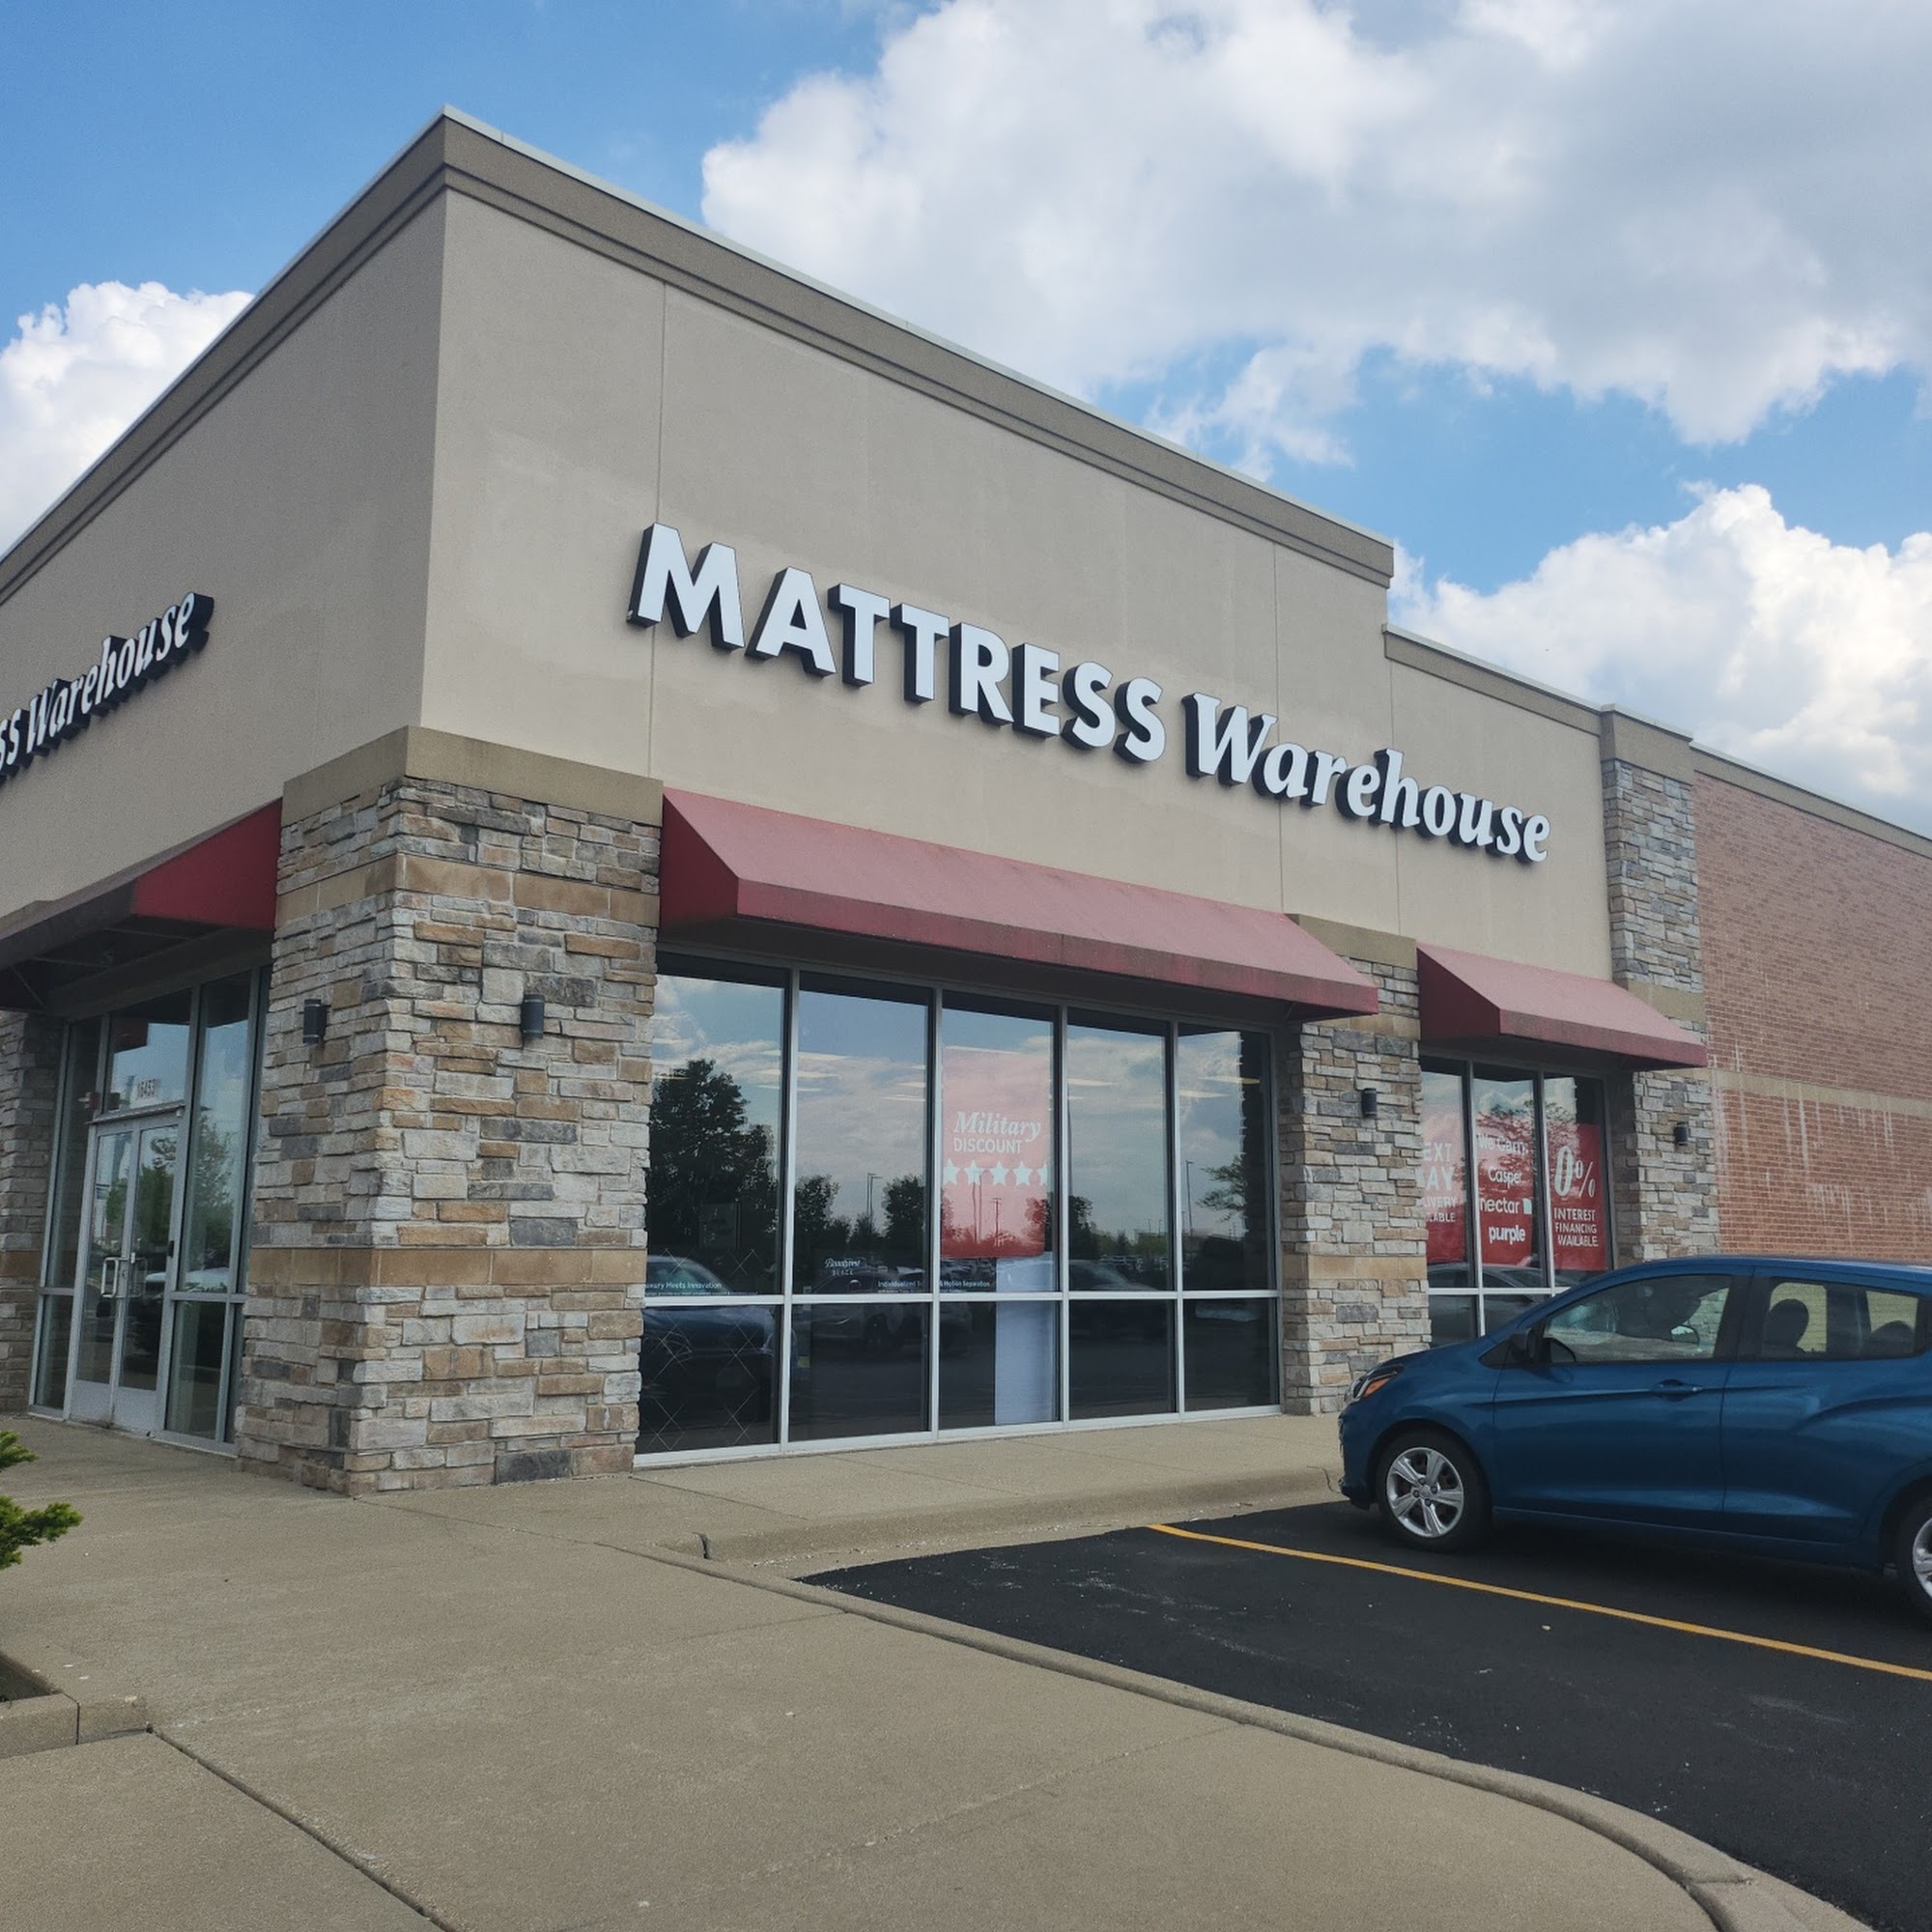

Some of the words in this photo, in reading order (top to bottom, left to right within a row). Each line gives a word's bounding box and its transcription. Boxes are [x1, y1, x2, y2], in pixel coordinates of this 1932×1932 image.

[26, 591, 195, 754] Warehouse
[628, 523, 1167, 763] MATTRESS
[1181, 692, 1551, 863] Warehouse
[952, 1111, 1041, 1143] Military
[953, 1137, 1022, 1153] DISCOUNT
[1554, 1145, 1596, 1198] 0%
[1480, 1197, 1520, 1214] nectar
[1553, 1208, 1596, 1222] INTEREST
[1489, 1225, 1526, 1245] purple
